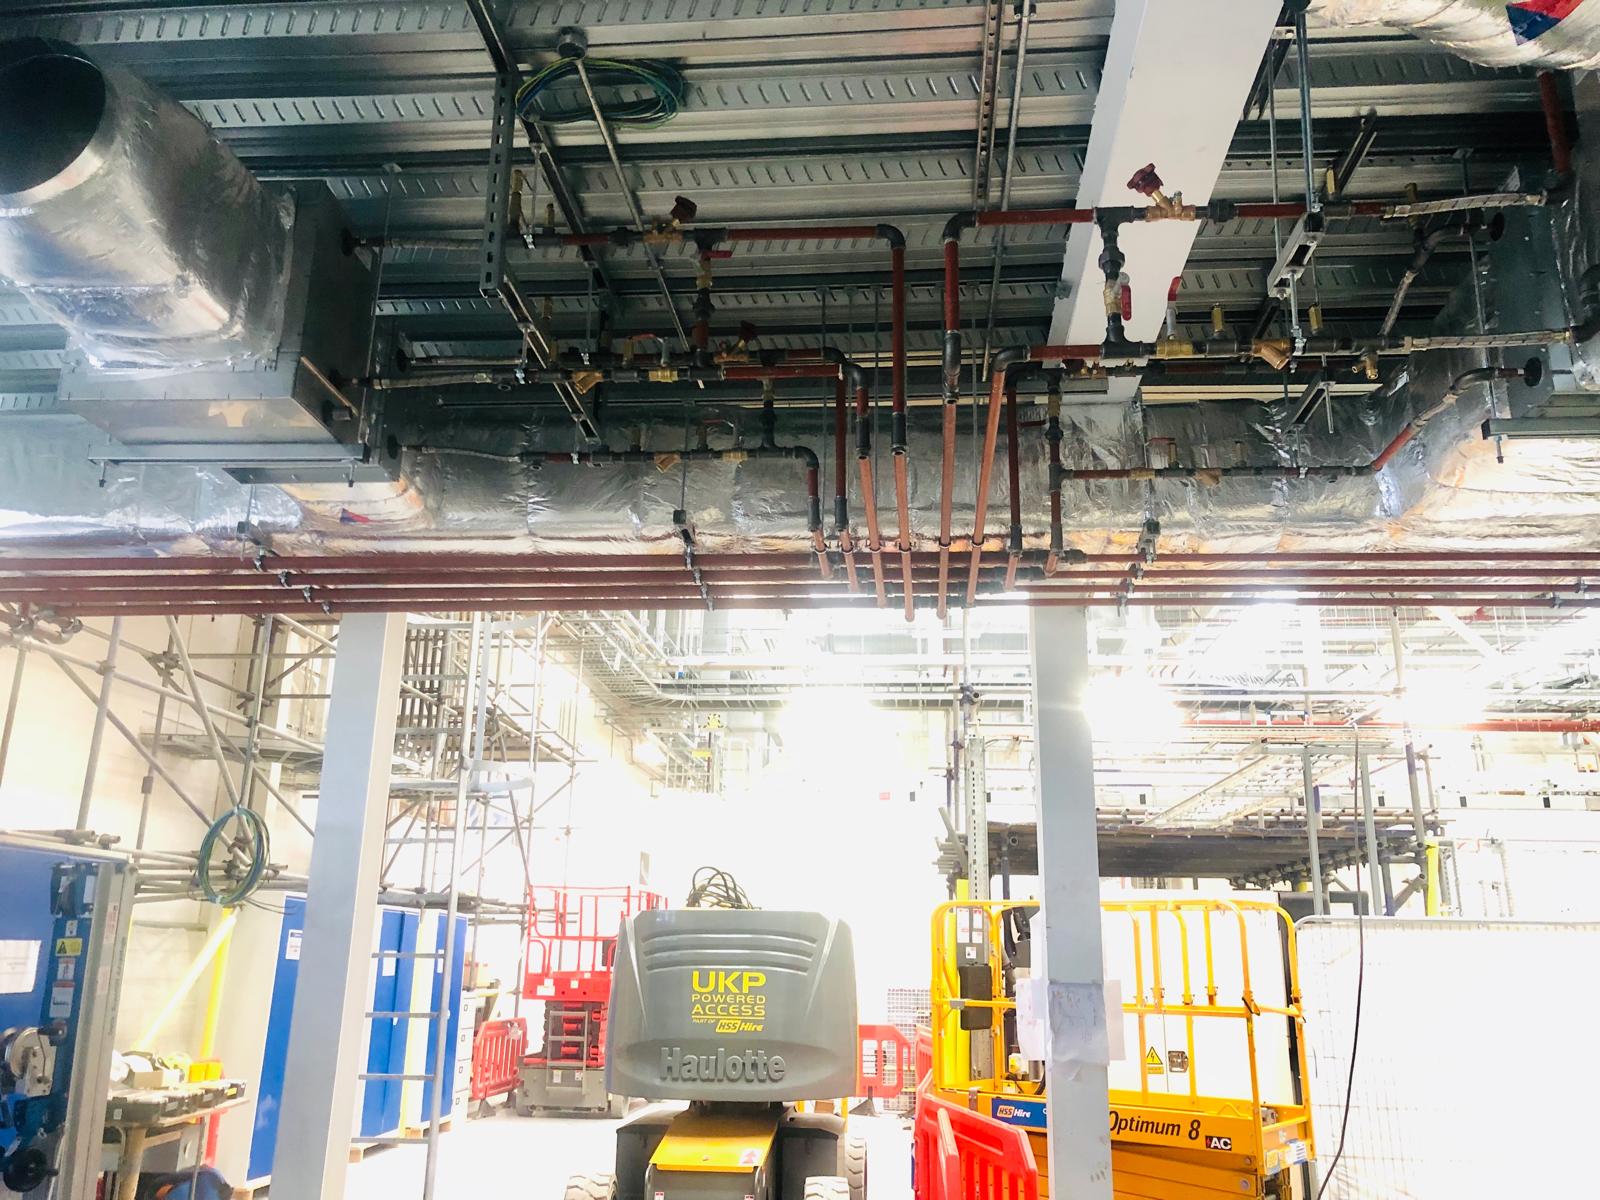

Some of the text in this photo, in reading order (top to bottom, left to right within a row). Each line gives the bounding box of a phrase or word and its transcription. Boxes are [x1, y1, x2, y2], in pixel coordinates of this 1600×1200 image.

[692, 970, 766, 993] UKP
[691, 993, 766, 1004] POWERED
[691, 1003, 766, 1016] ACCESS
[718, 1021, 764, 1032] HSS Hire
[660, 1047, 786, 1083] Haulotte
[998, 1106, 1013, 1117] HSS
[1013, 1109, 1032, 1118] Hire
[1188, 1119, 1201, 1141] 8
[1210, 1137, 1232, 1150] AC
